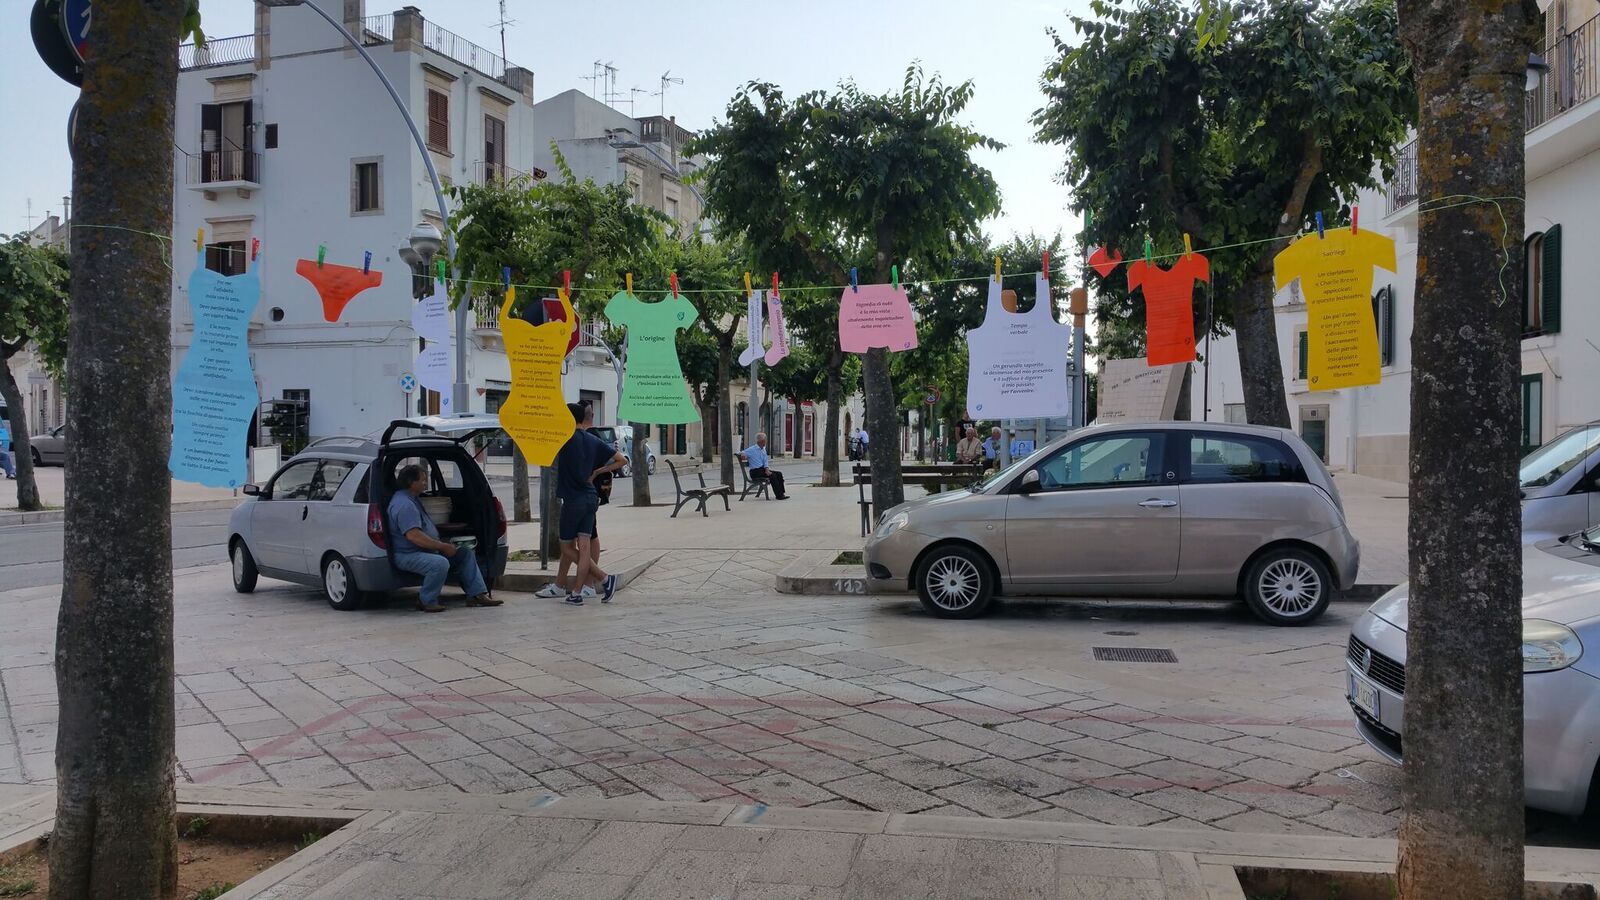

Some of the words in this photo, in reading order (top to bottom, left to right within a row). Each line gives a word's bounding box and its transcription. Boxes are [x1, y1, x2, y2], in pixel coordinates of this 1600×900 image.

[1320, 279, 1340, 287] Charlie
[640, 335, 666, 343] L'origine
[1001, 362, 1022, 370] gerundio
[1024, 361, 1044, 369] saporito
[1134, 370, 1162, 379] DIMENTICARE
